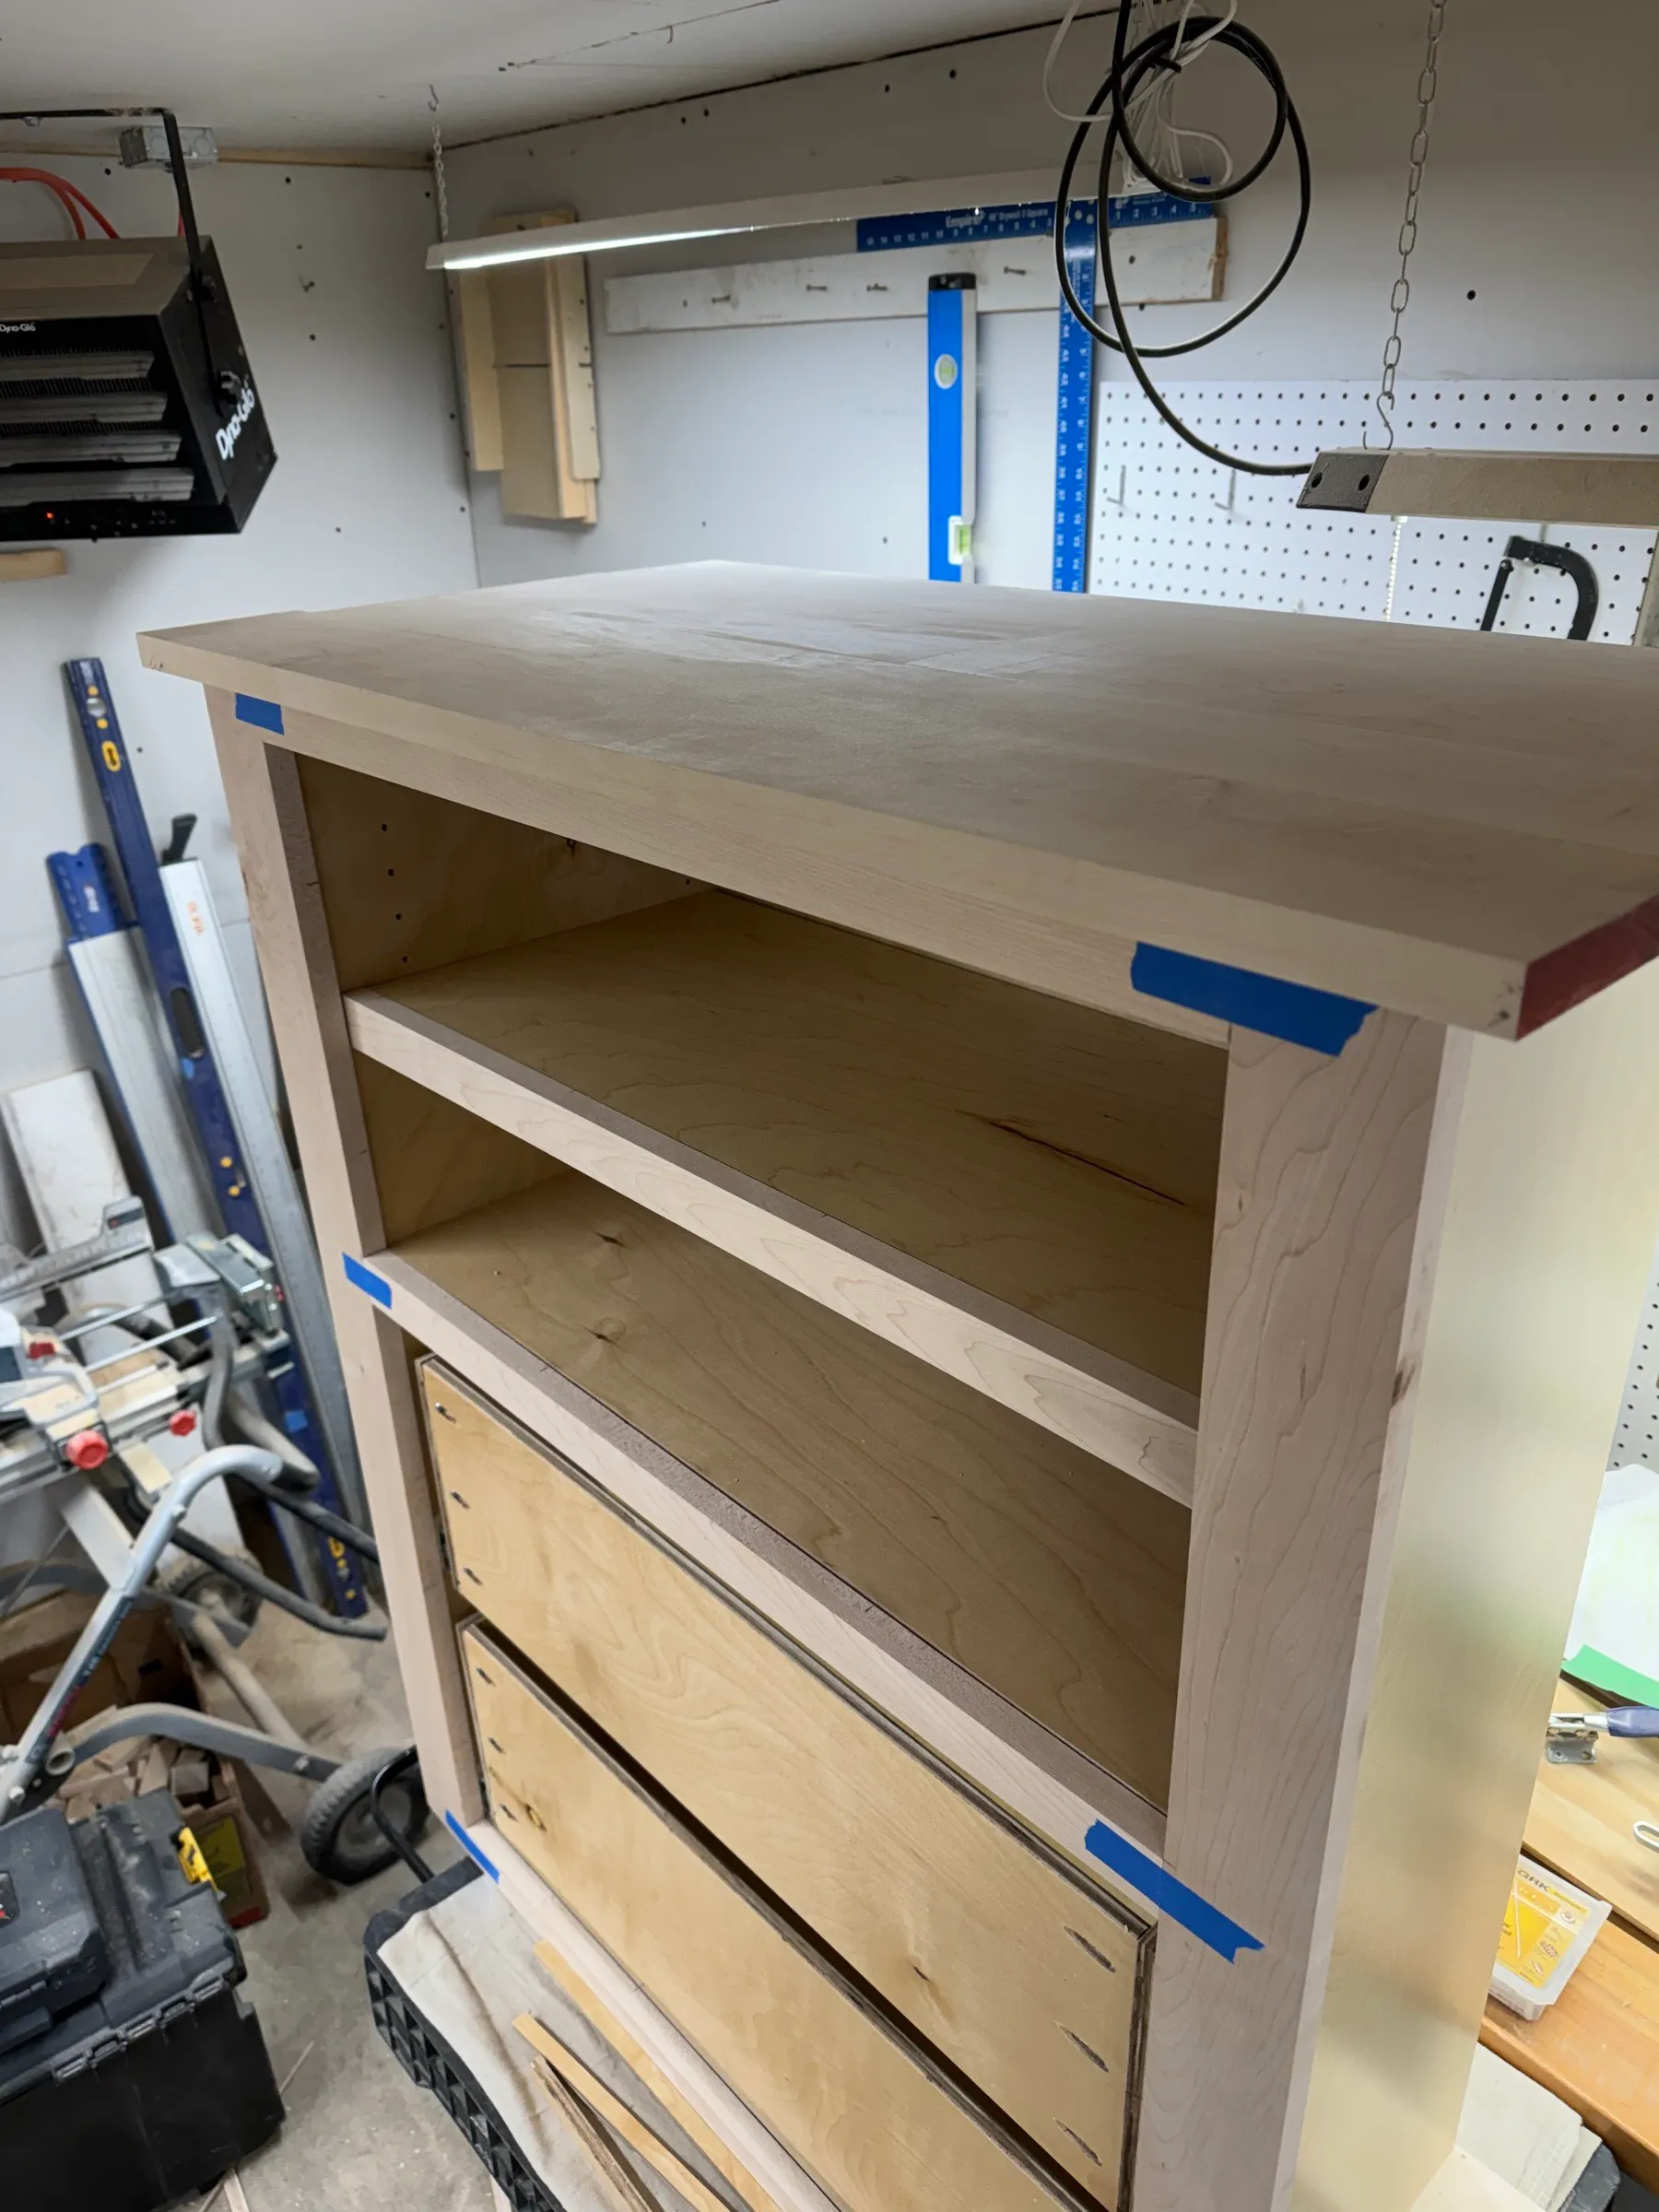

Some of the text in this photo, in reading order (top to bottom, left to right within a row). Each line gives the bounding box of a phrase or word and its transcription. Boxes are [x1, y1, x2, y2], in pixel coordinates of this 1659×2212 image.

[1134, 208, 1140, 218] 2
[1152, 206, 1159, 217] 3
[1171, 204, 1177, 213] 4
[945, 213, 982, 229] Empire
[1517, 1869, 1550, 1892] GRK
